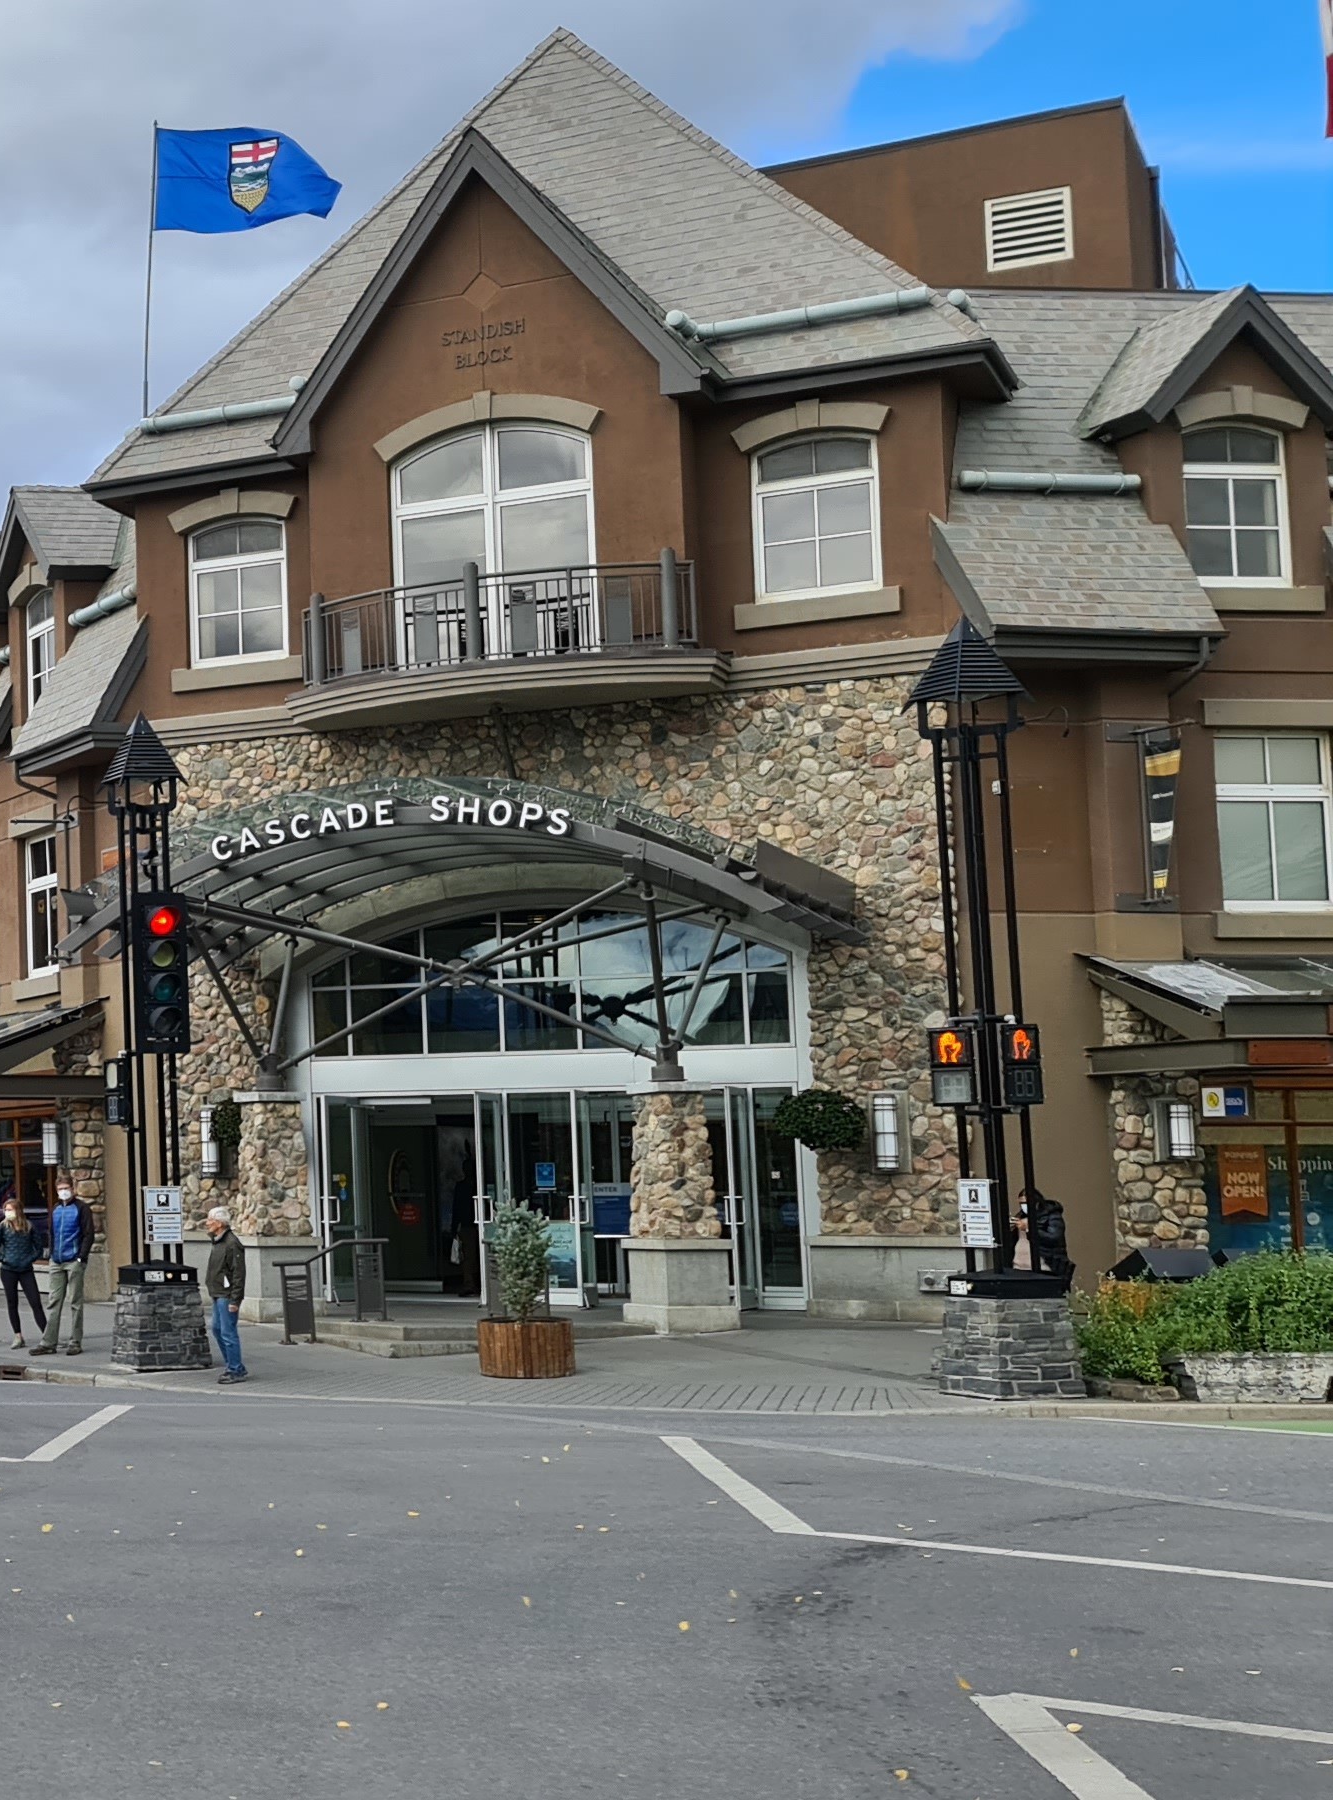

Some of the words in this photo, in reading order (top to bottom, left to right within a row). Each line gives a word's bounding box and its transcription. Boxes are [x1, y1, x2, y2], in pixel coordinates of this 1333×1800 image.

[441, 318, 526, 347] STANDISH
[454, 345, 514, 370] BLOCK
[211, 799, 394, 861] CASCADE
[429, 795, 571, 836] SHOPS
[1227, 1172, 1260, 1184] NOW
[1222, 1185, 1265, 1199] OPEN!
